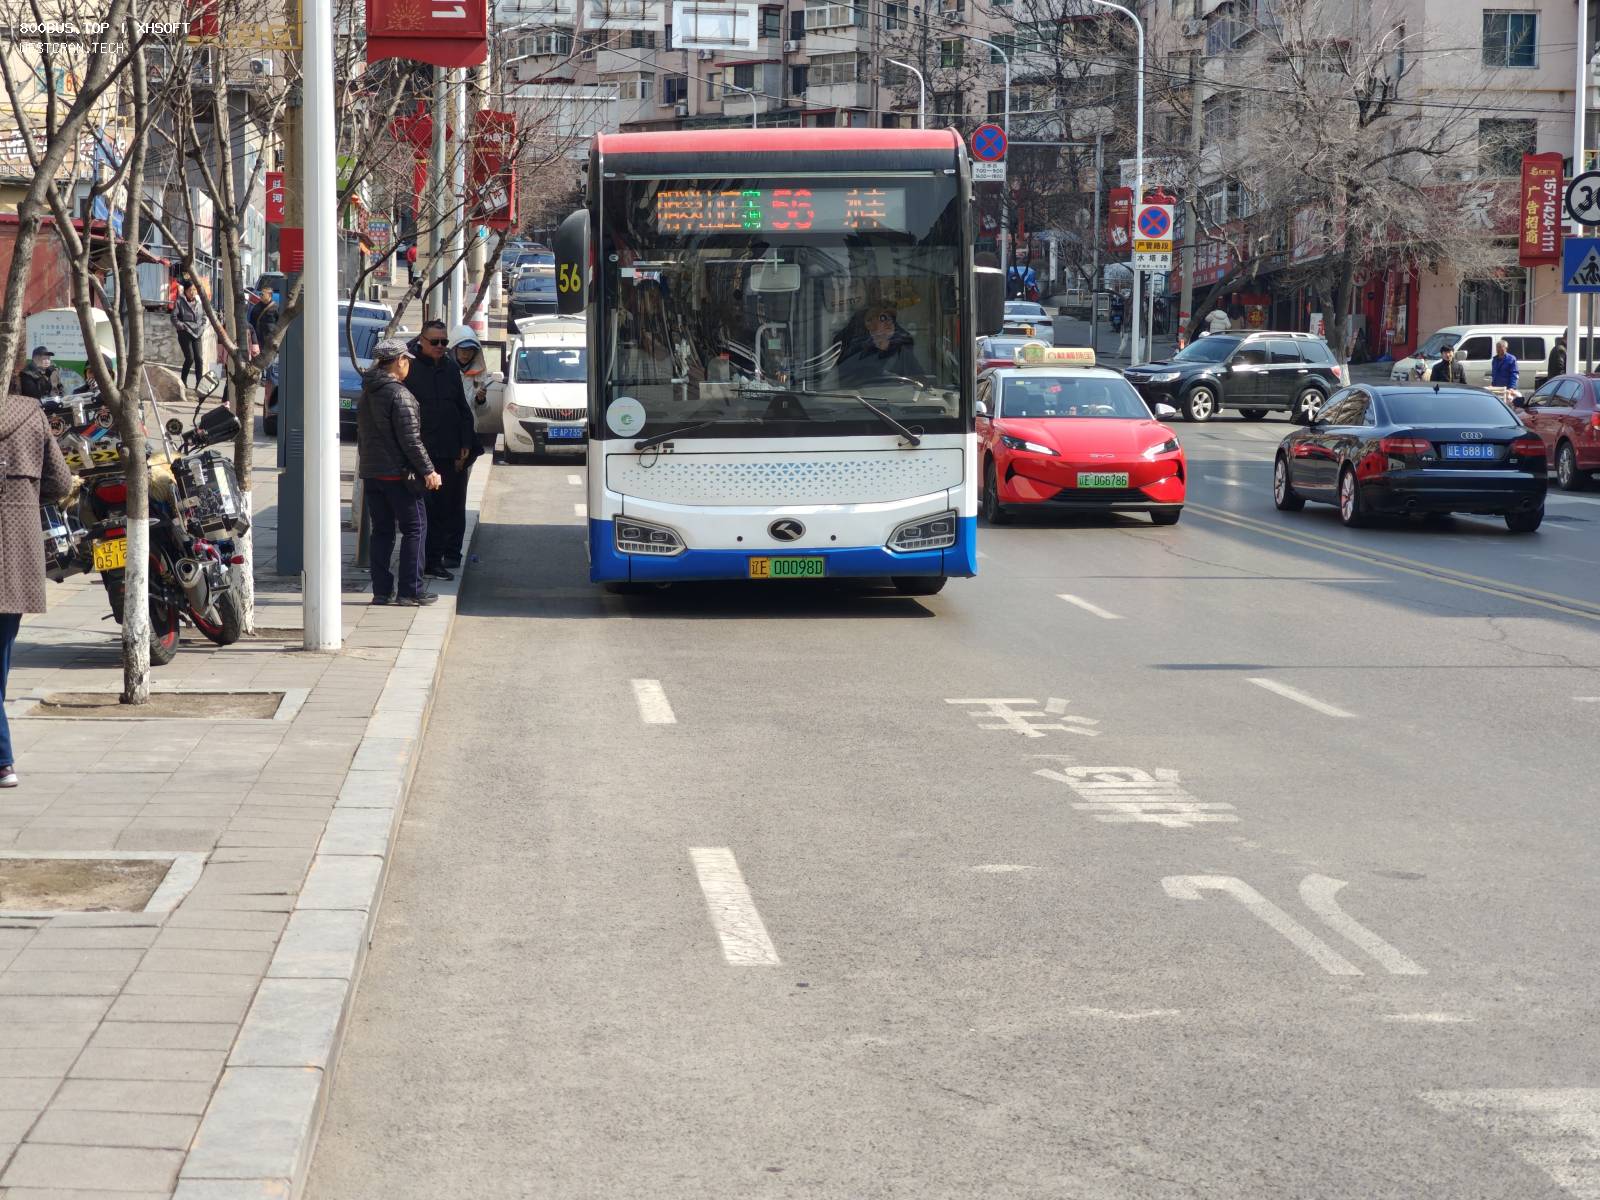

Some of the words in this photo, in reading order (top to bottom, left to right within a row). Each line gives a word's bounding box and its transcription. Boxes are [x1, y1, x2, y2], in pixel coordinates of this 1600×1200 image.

[772, 189, 814, 230] 56
[1580, 185, 1600, 211] 3
[1525, 186, 1541, 244] 广告招商
[1542, 178, 1557, 252] 157-1424-1111
[1137, 241, 1169, 250] 严管路段
[1137, 254, 1169, 262] 水塔路
[559, 263, 581, 293] 56
